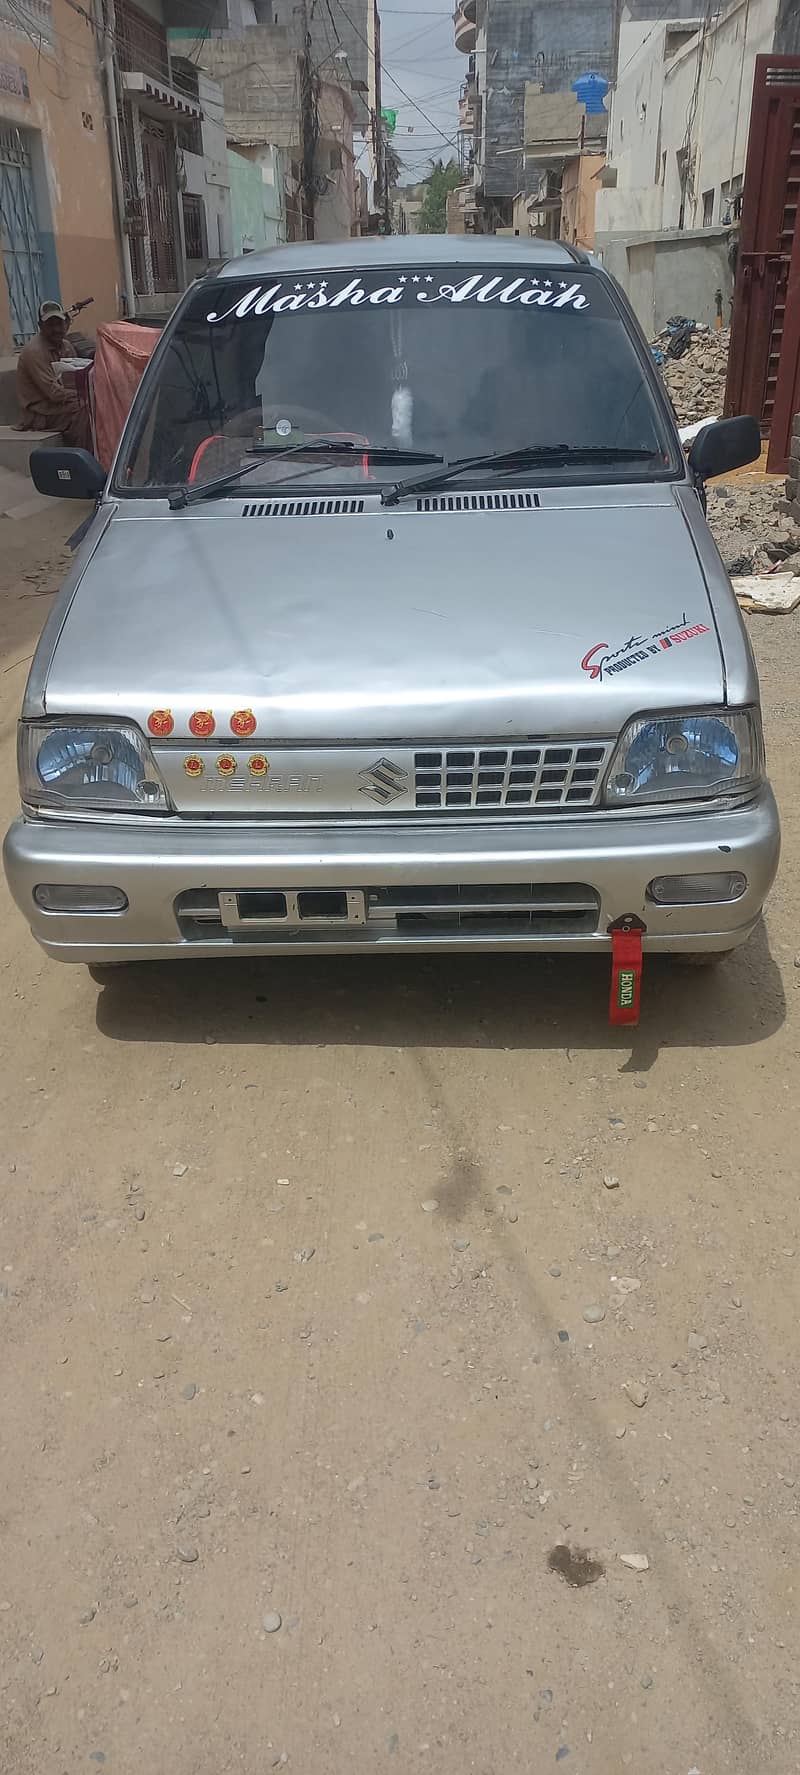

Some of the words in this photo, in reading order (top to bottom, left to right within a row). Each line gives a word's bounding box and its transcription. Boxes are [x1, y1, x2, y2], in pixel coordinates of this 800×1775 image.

[206, 278, 404, 323] Masha
[417, 274, 590, 311] Allah
[652, 612, 690, 640] mind
[603, 650, 649, 676] PRODUCTED
[646, 644, 661, 655] BY
[669, 623, 710, 644] SUZUKI
[621, 973, 633, 1006] HONDA
